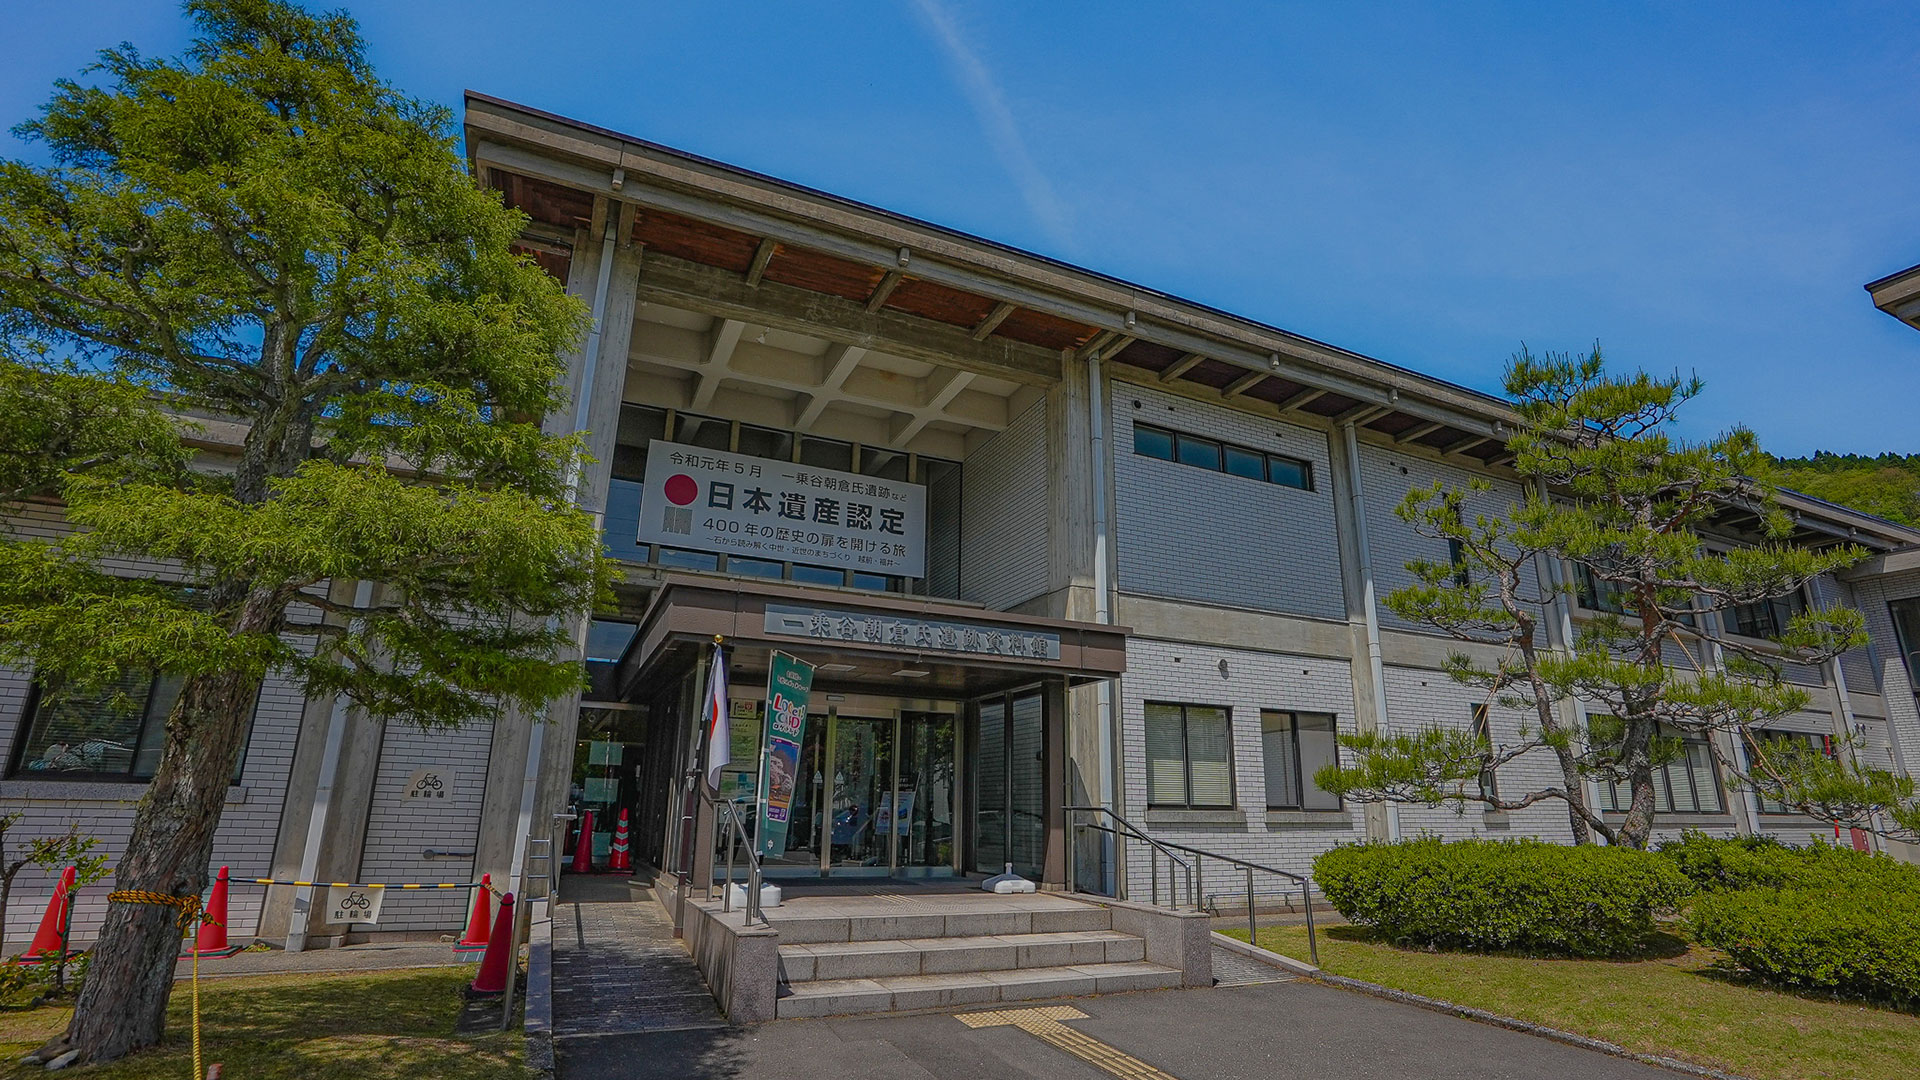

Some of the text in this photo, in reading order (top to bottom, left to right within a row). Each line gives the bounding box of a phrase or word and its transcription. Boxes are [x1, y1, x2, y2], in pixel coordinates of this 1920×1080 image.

[782, 473, 907, 502] 一乗谷朝倉氏遺跡など
[708, 480, 905, 536] 日本遺産認定
[782, 612, 1050, 657] 一乗谷朝倉氏遺跡資料館
[410, 790, 445, 798] 駐輪場
[334, 910, 372, 919] 駐輪場
